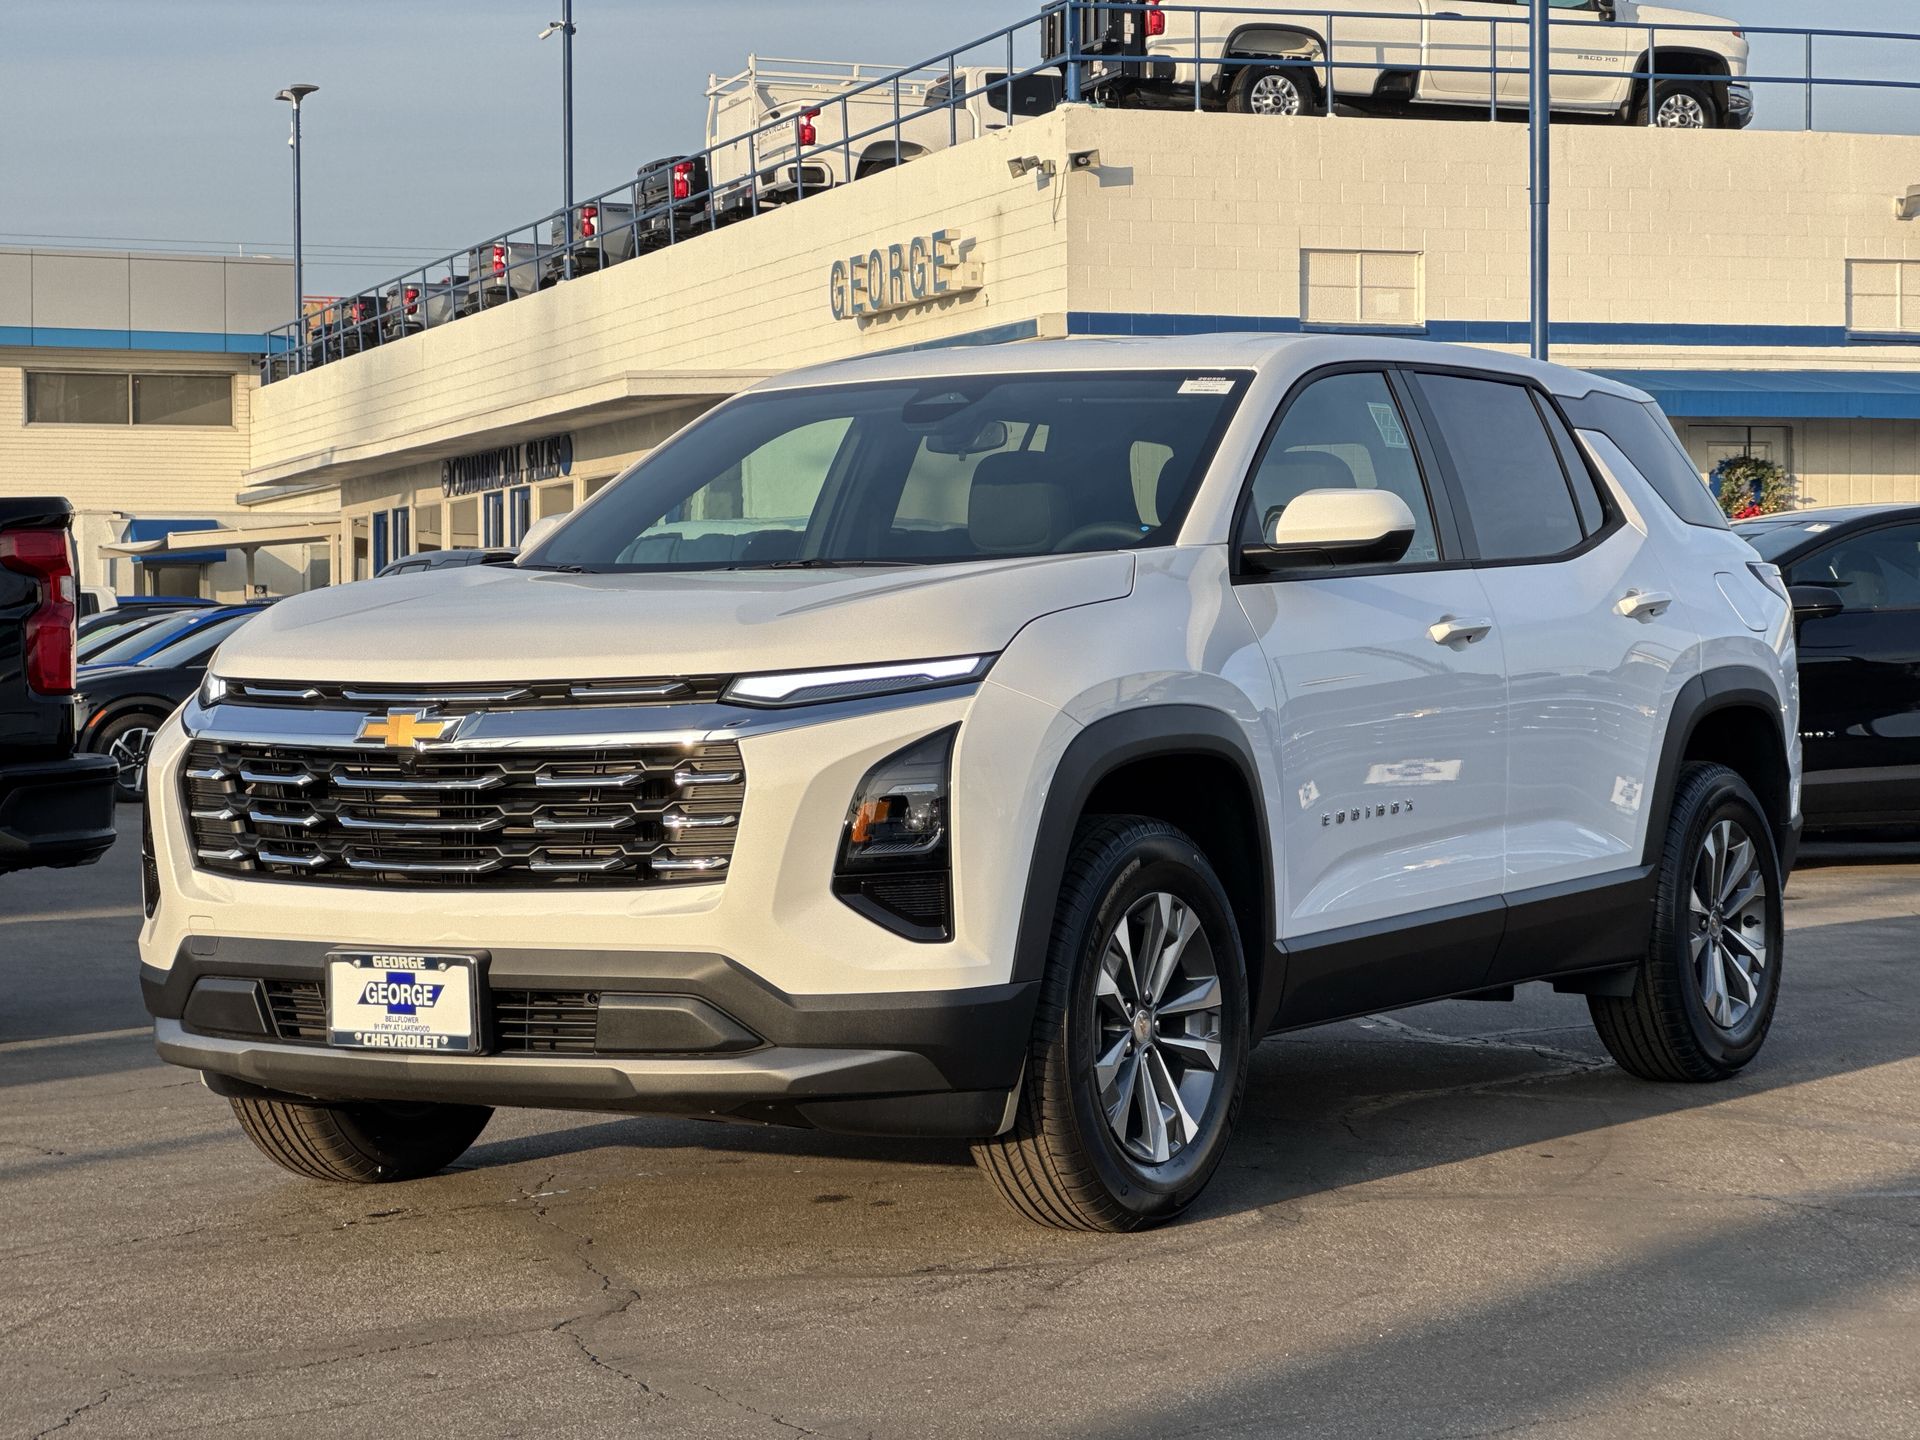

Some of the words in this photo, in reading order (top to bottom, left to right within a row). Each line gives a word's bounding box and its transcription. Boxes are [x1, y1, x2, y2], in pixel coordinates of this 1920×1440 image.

[830, 229, 956, 321] GEORGE
[1321, 799, 1414, 827] EQUINOX
[372, 955, 426, 970] GEORGE
[365, 983, 433, 1006] GEORGE
[385, 1015, 419, 1023] BELLFLOWER
[374, 1023, 380, 1031] 91
[401, 1024, 430, 1033] LAKEWOOD
[363, 1032, 440, 1049] CHEVROLET
